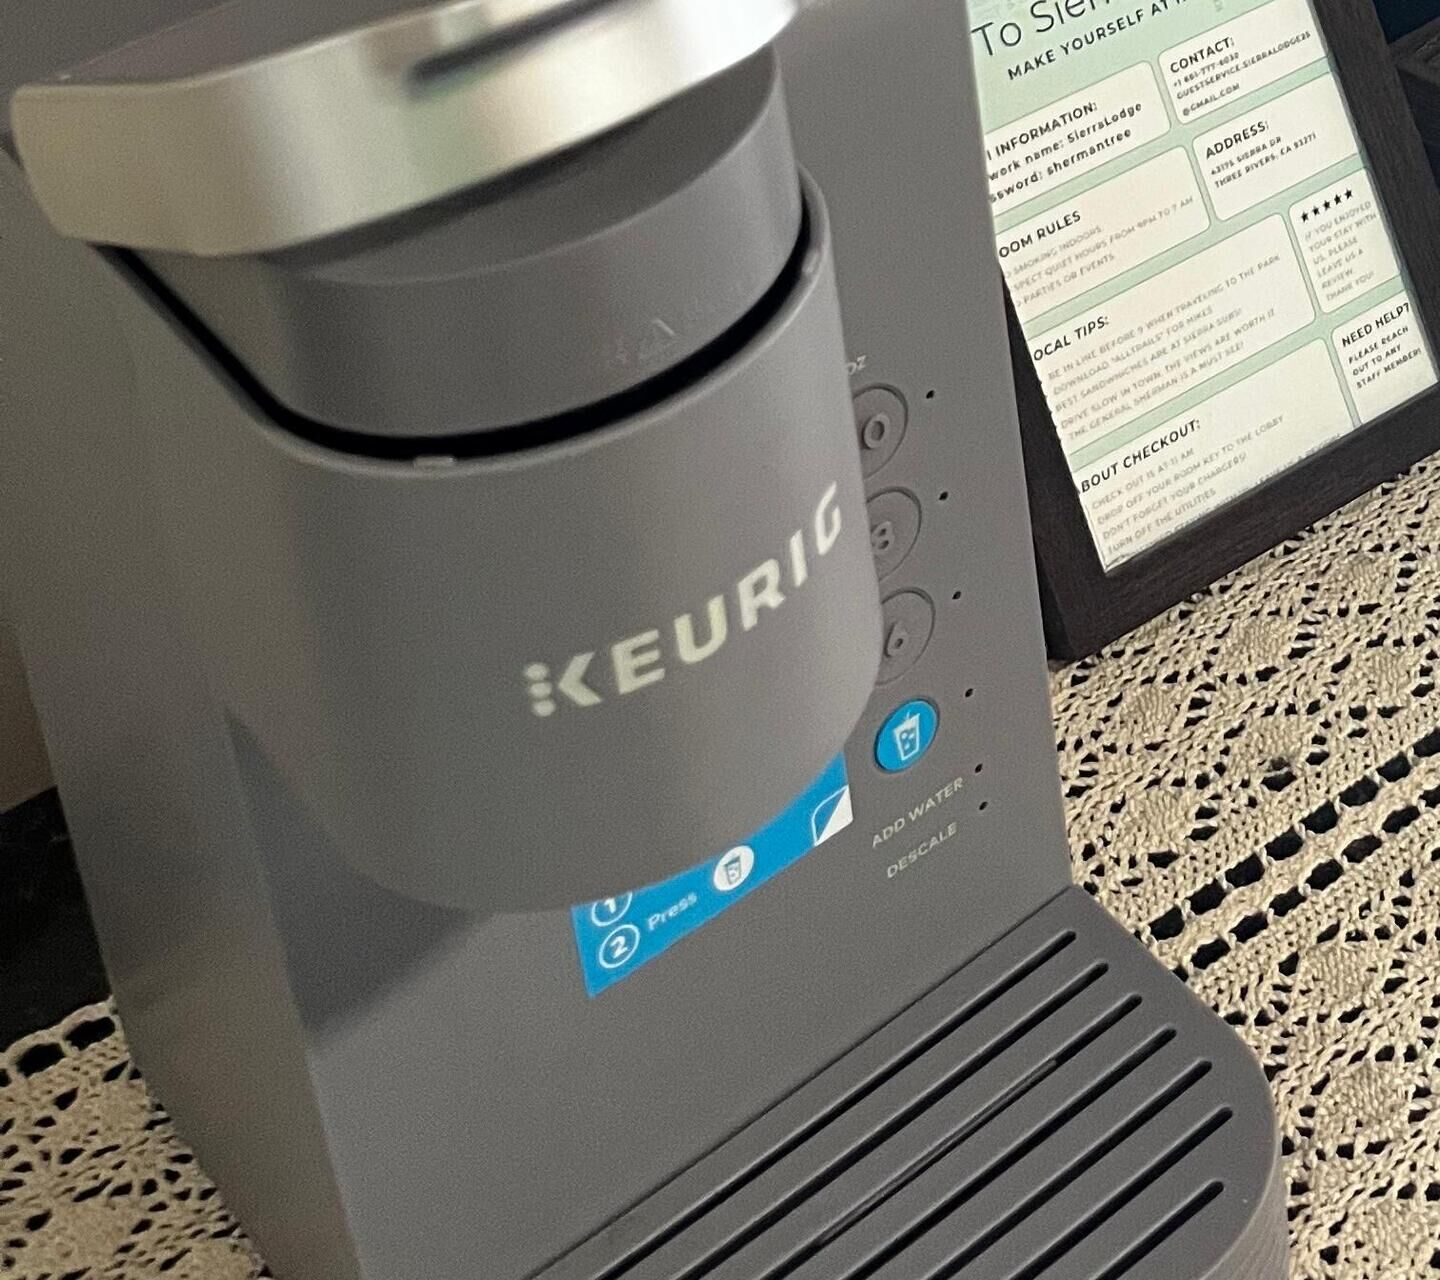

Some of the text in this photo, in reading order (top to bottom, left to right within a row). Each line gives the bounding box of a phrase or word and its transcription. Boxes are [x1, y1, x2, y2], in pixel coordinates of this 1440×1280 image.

[969, 21, 1021, 56] To
[1007, 49, 1055, 80] MAKE
[1059, 8, 1143, 55] YOURSELF
[1170, 36, 1234, 73] CONTACT:
[1182, 82, 1239, 116] @GMAIL.COM
[987, 103, 1141, 180] work name: SierraLodge
[995, 102, 1097, 156] INFORMATION:
[1206, 121, 1268, 159] ADDRESS:
[1236, 143, 1267, 162] SIERRA
[1269, 136, 1281, 147] DR
[987, 129, 1130, 203] ssword: shermantree
[1214, 169, 1242, 187] THREE
[1280, 145, 1291, 155] CA
[1293, 132, 1316, 149] 93271
[1000, 210, 1080, 257] OOM RULES
[1013, 270, 1041, 290] SPECT
[1044, 255, 1072, 275] QUIET
[1074, 239, 1107, 260] HOURS
[1109, 225, 1135, 243] FROM
[1157, 207, 1170, 218] TO
[1180, 195, 1193, 208] AM
[1308, 212, 1376, 252] YOUR STAY WITH
[1313, 220, 1332, 234] YOU
[1333, 200, 1371, 225] ENJOYED
[1317, 258, 1342, 278] LEAVE
[1344, 250, 1356, 262] US
[1327, 236, 1357, 256] PLEASE
[1023, 279, 1061, 304] PARTIES
[1063, 271, 1077, 282] OR
[1325, 282, 1353, 301] THANK
[1033, 316, 1108, 360] OCAL TIPS:
[1047, 368, 1061, 380] BE
[1062, 362, 1073, 372] IN
[1075, 349, 1096, 366] LINE
[1098, 329, 1135, 354] BEFORE
[1145, 309, 1173, 329] WHEN
[1175, 283, 1223, 313] TRAVELING
[1224, 276, 1237, 287] TO
[1238, 266, 1254, 280] THE
[1257, 255, 1280, 270] PARK
[1341, 302, 1409, 347] NEED HELP?
[1348, 325, 1408, 364] PLEASE REACH
[1053, 360, 1109, 395] DOWNLOAD
[1165, 320, 1184, 336] FOR
[1054, 394, 1077, 412] BEST
[1150, 347, 1168, 361] ARE
[1170, 339, 1180, 350] AT
[1182, 322, 1214, 344] SIERRA
[1060, 307, 1274, 429] DRIVE SLOW IN THE VIEWS ARE WORTH IT
[1352, 343, 1400, 375] OUT TO ANY
[1356, 370, 1380, 388] STAFF
[1068, 425, 1088, 439] THE
[1089, 403, 1132, 429] GENERAL
[1133, 377, 1178, 405] SHERMAN
[1179, 370, 1189, 382] IS
[1198, 351, 1222, 370] MUST
[1081, 419, 1200, 493] BOUT CHECKOUT:
[1091, 489, 1122, 509] CHECK
[1124, 474, 1143, 491] OUT
[1146, 469, 1155, 480] IS
[1157, 461, 1168, 473] AT
[1180, 447, 1194, 460] AM
[1096, 415, 1282, 524] DROP OFF YOUR ROOM KEY TO THE LOBBY
[1107, 535, 1133, 554] TURN
[1134, 522, 1151, 540] OFF
[1154, 511, 1173, 527] THE
[1174, 487, 1216, 516] UTILITIES
[1132, 496, 1167, 522] FORGET
[1169, 481, 1195, 500] YOUR
[524, 480, 842, 716] KEURIG
[872, 777, 963, 848] ADD WATER
[887, 822, 957, 878] DESCALE
[611, 892, 698, 959] 2 Press
